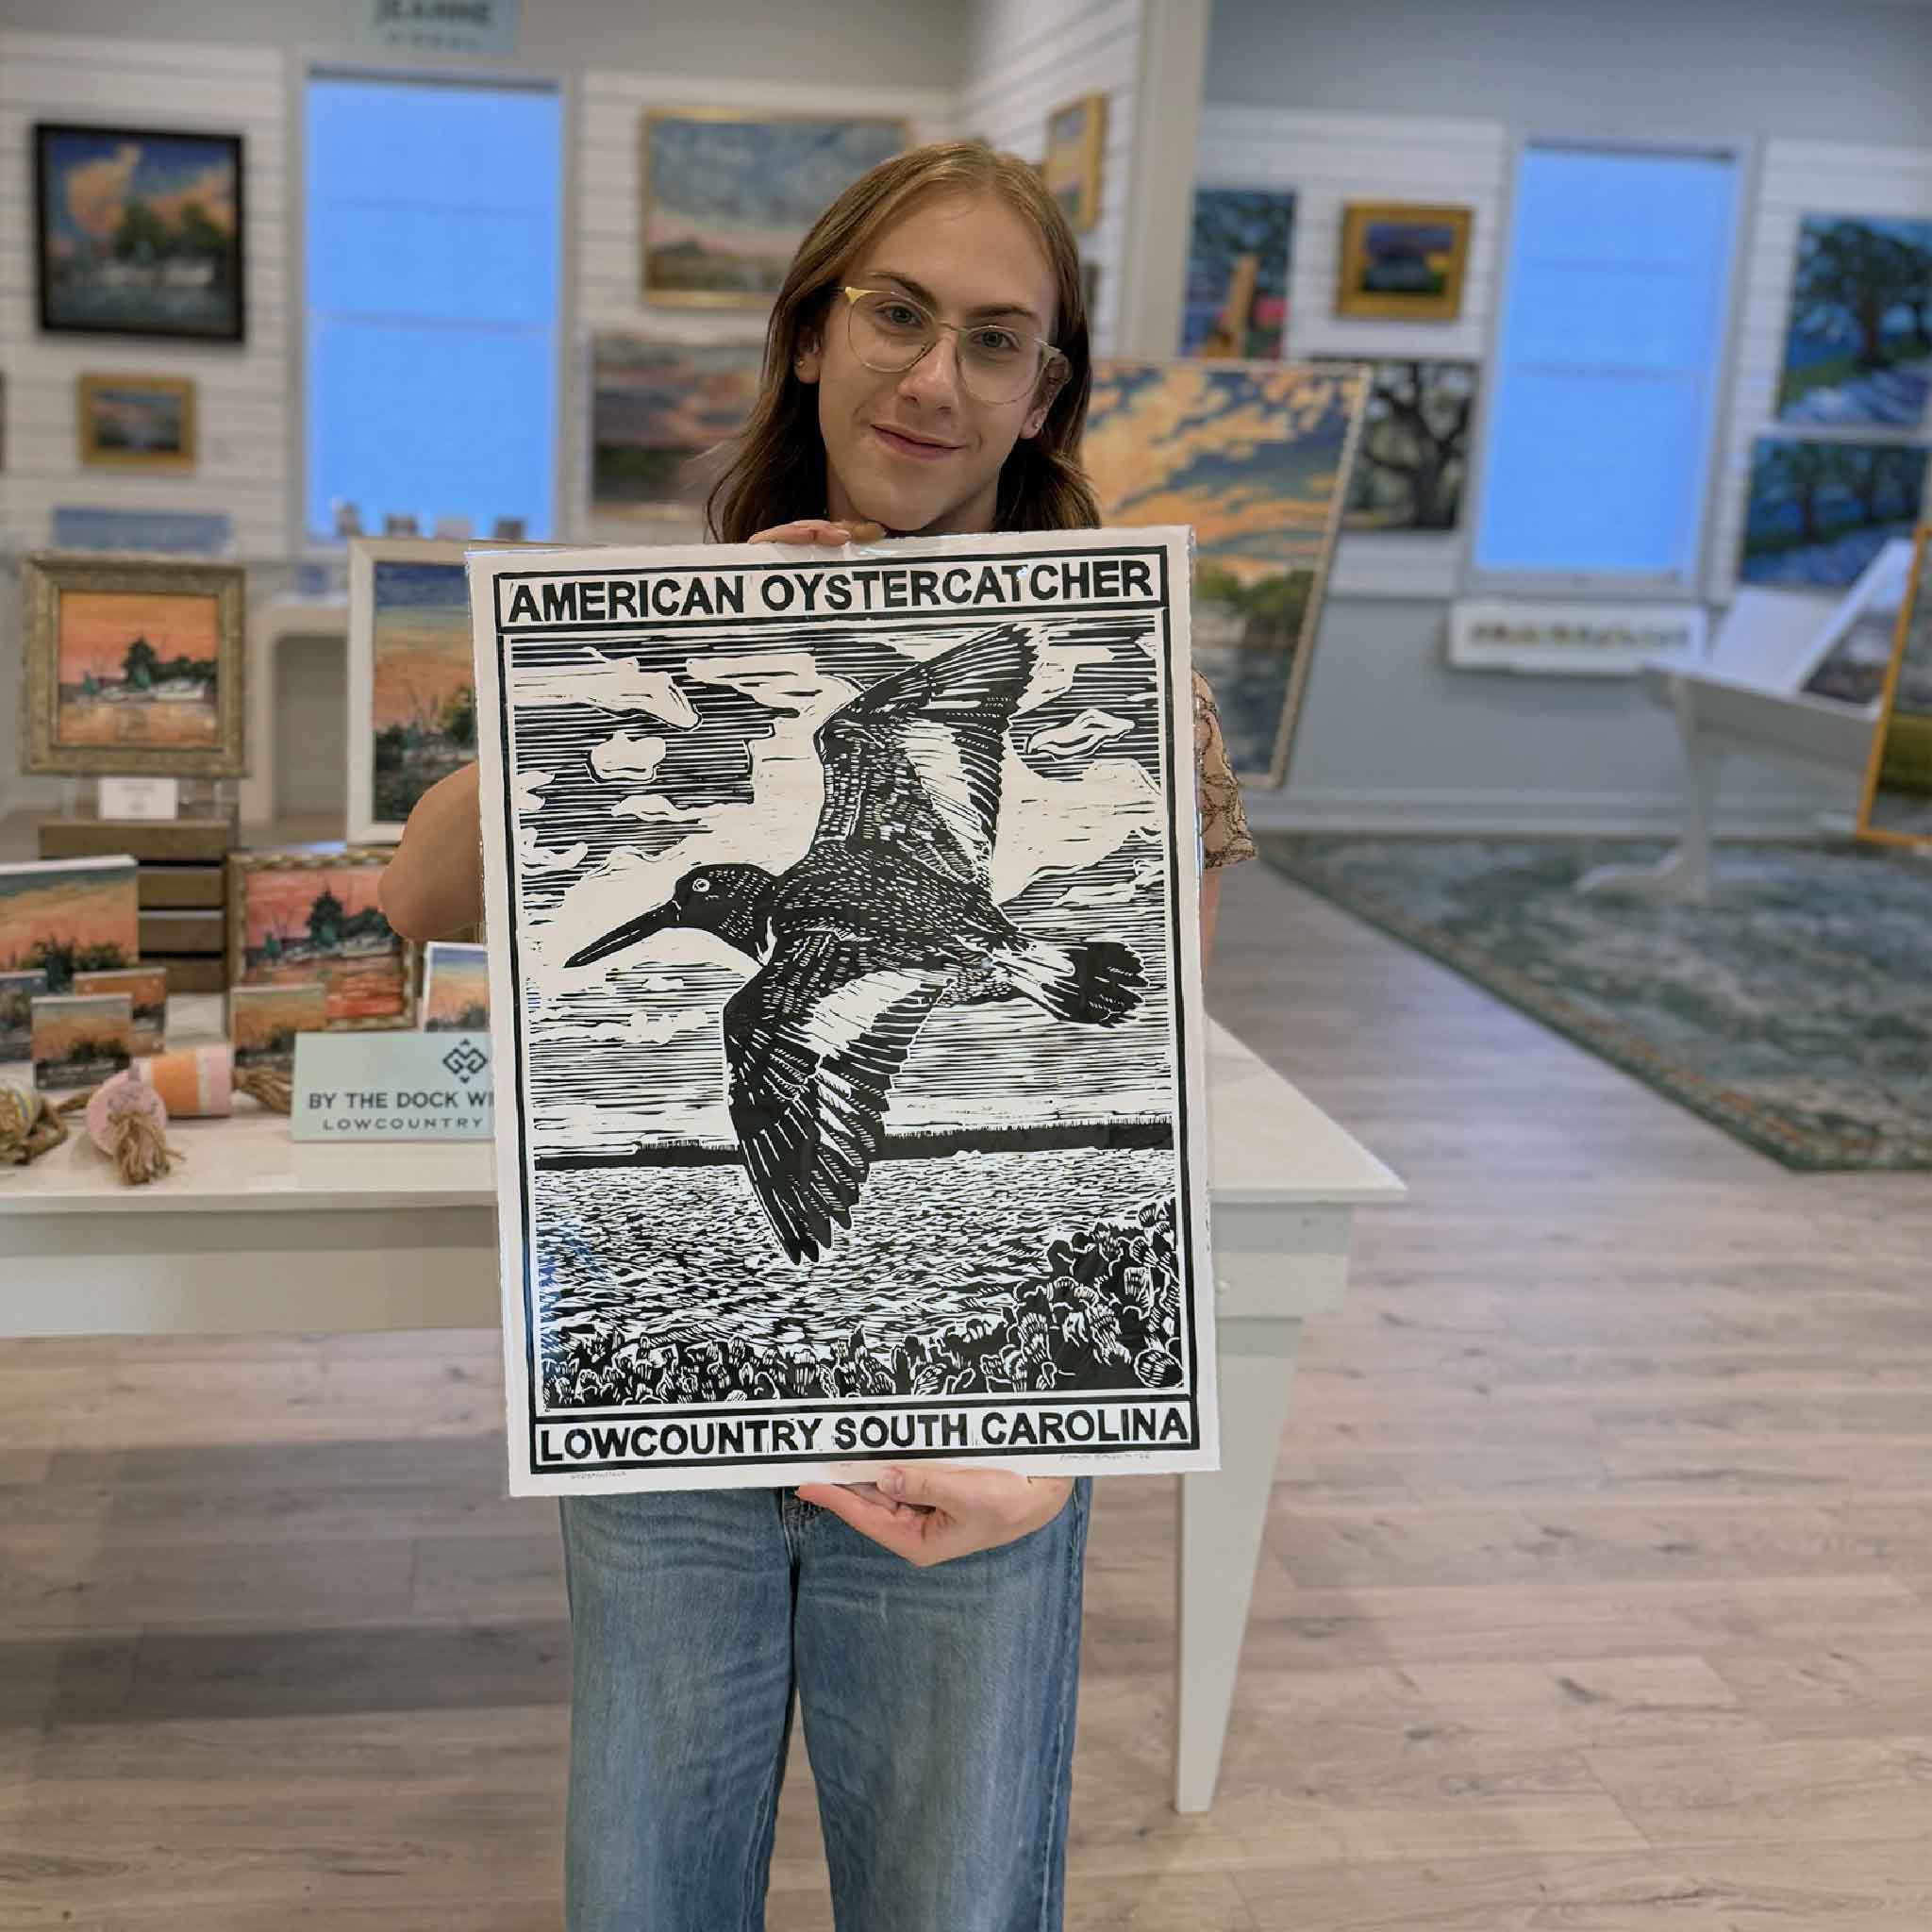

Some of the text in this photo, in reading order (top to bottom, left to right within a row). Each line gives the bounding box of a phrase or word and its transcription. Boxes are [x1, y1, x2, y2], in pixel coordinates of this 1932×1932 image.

[508, 559, 1154, 623] AMERICAN OYSTERCATCHER
[309, 1093, 337, 1109] BY
[345, 1092, 388, 1108] THE
[396, 1092, 458, 1108] DOCK
[324, 1117, 484, 1130] LOWCOUNTRY
[541, 1407, 1189, 1462] LOWCOUNTRY SOUTH CAROLINA
